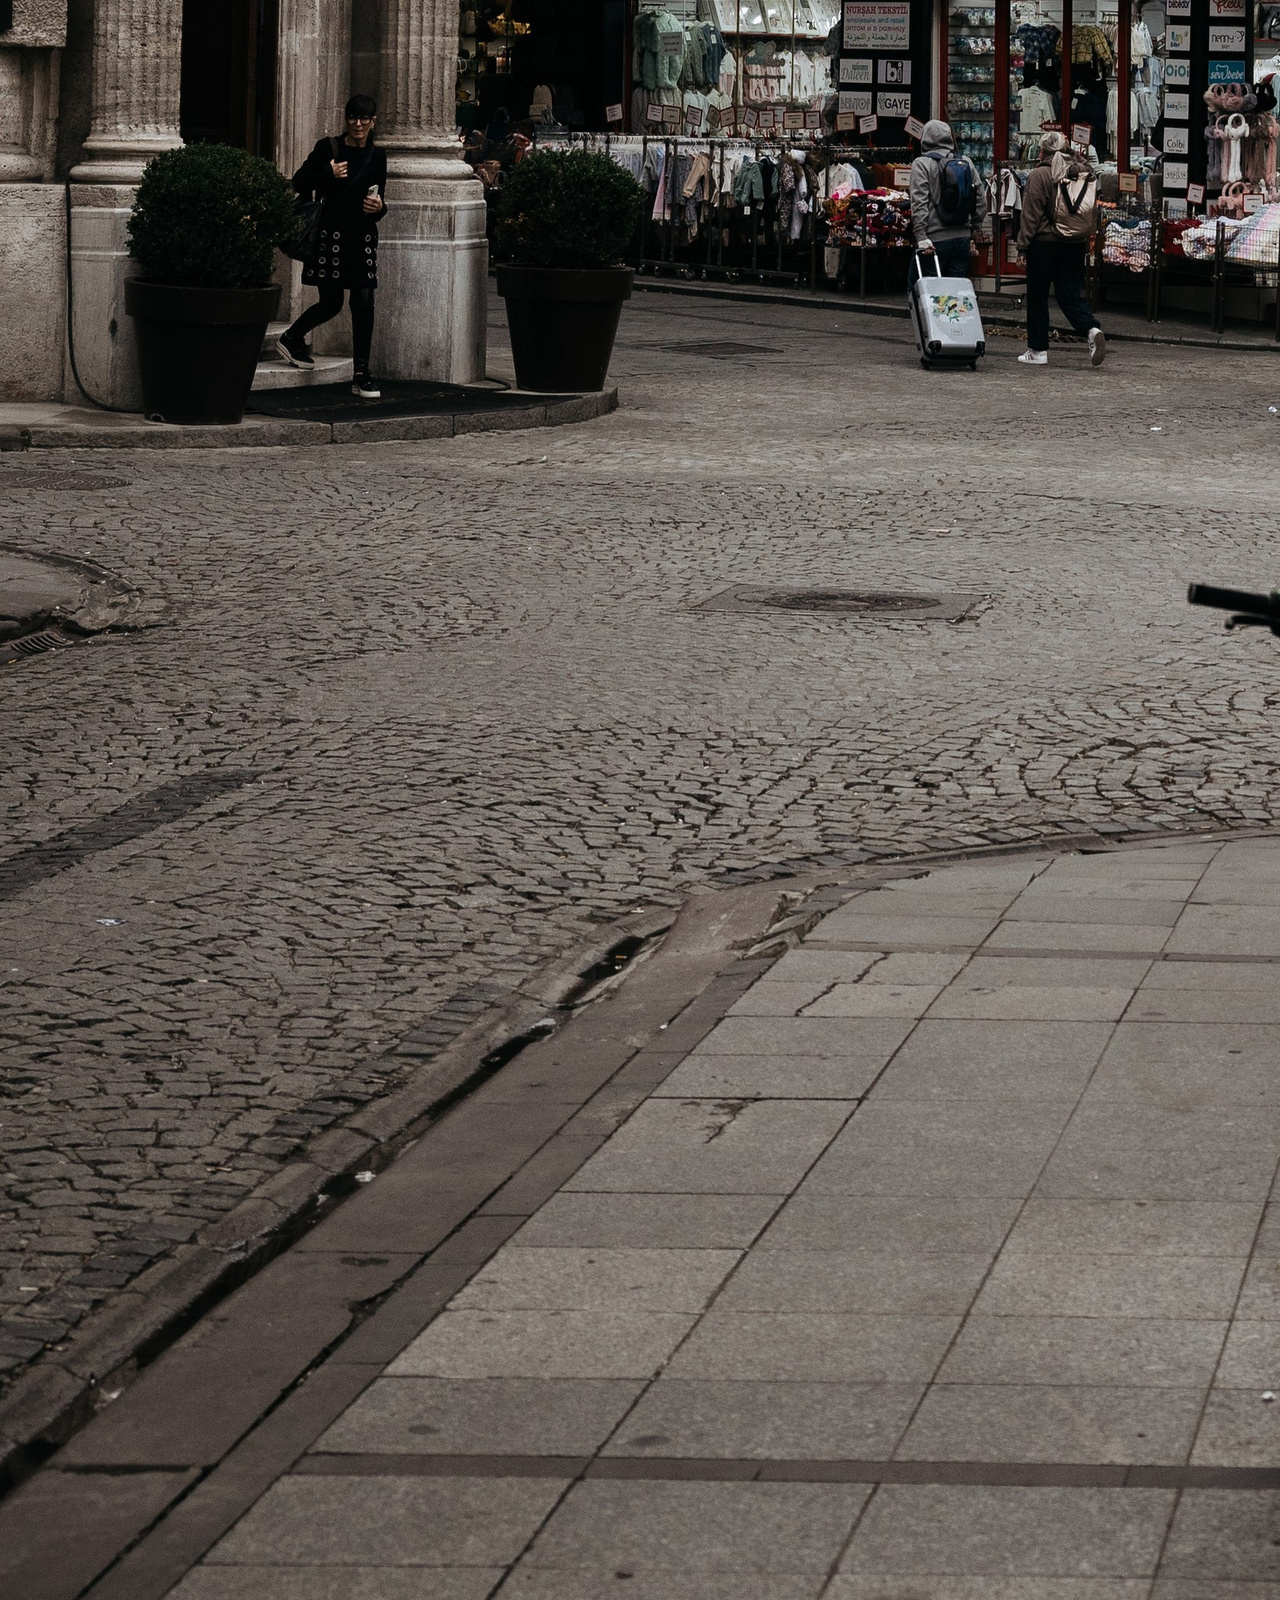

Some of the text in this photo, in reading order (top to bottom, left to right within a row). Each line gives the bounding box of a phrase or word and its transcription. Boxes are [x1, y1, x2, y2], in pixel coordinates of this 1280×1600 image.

[846, 4, 909, 17] NURŞAH TEKSTİL
[884, 98, 910, 110] GAYE
[1166, 139, 1185, 149] Colbi
